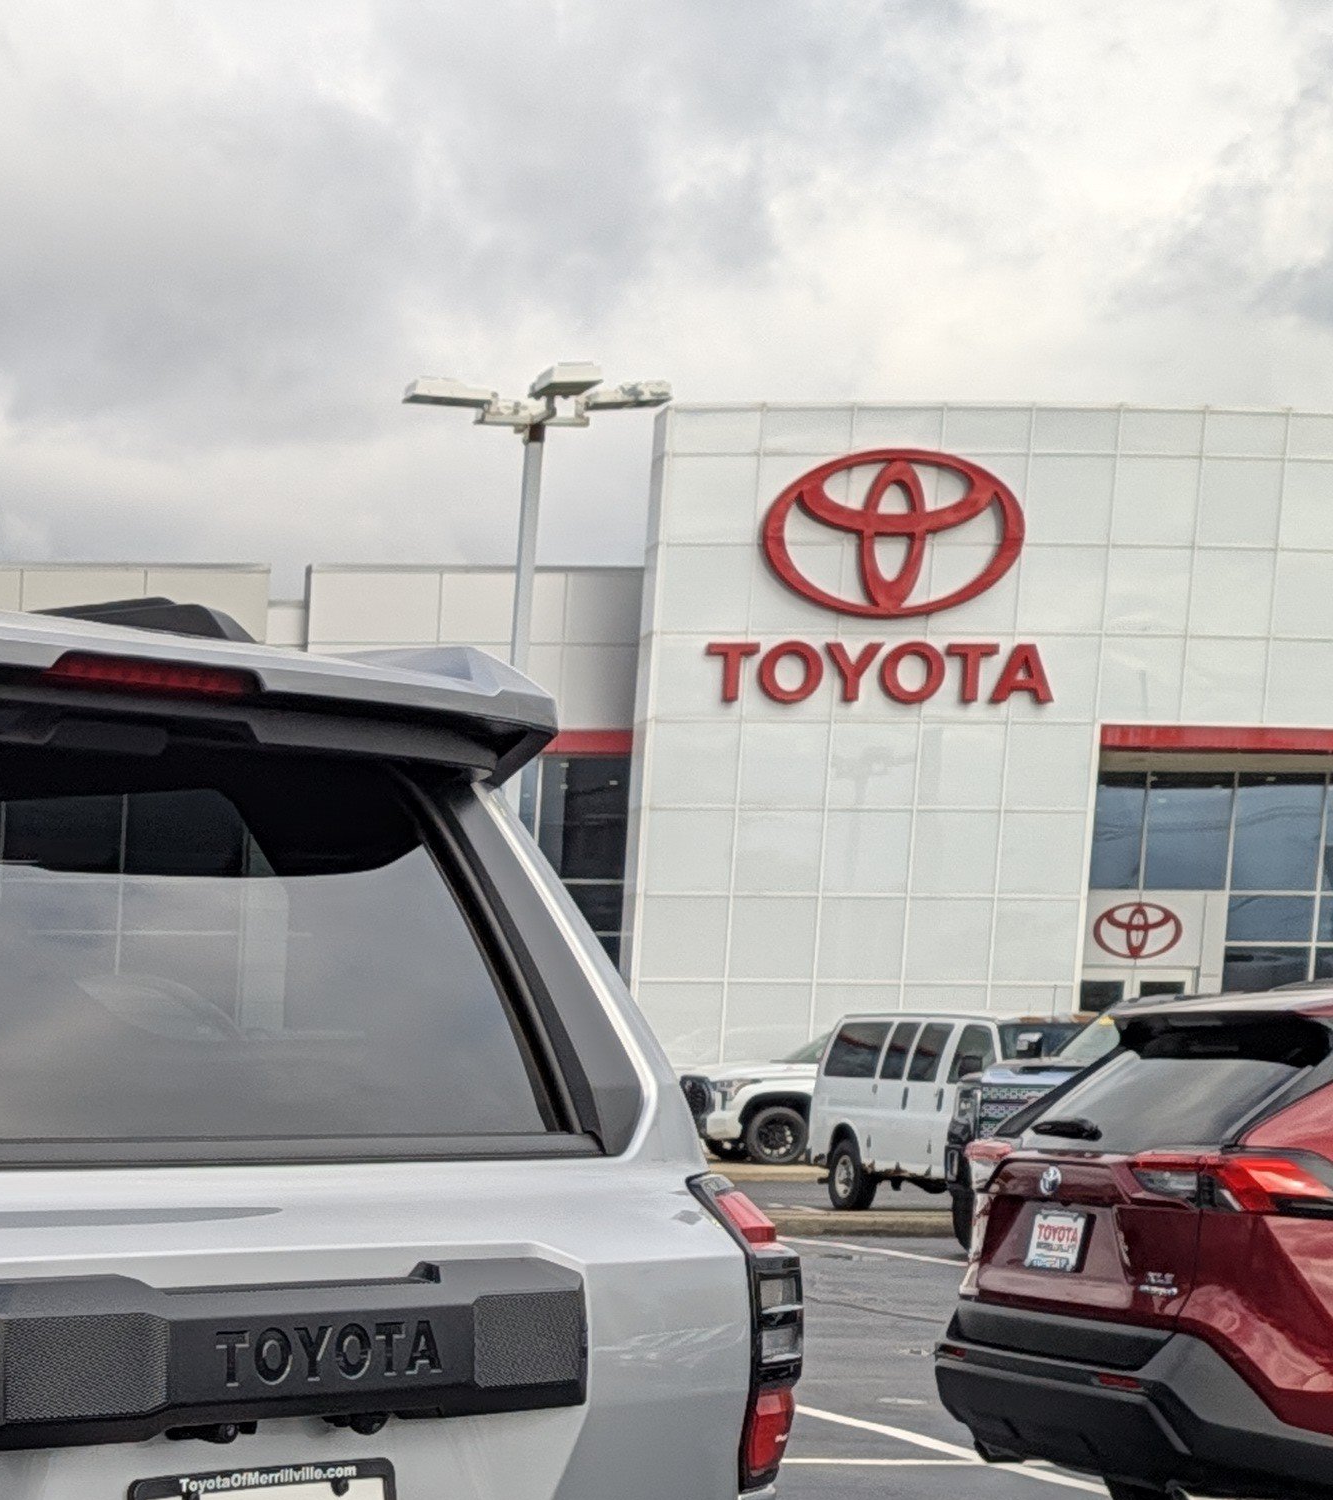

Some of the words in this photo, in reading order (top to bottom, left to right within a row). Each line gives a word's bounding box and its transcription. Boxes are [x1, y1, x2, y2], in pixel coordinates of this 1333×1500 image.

[706, 640, 1055, 705] TOYOTA
[1037, 1223, 1079, 1243] TOYOTA
[215, 1319, 443, 1388] TOYOTA
[179, 1464, 358, 1495] ToyotaOfMerrillville.com
